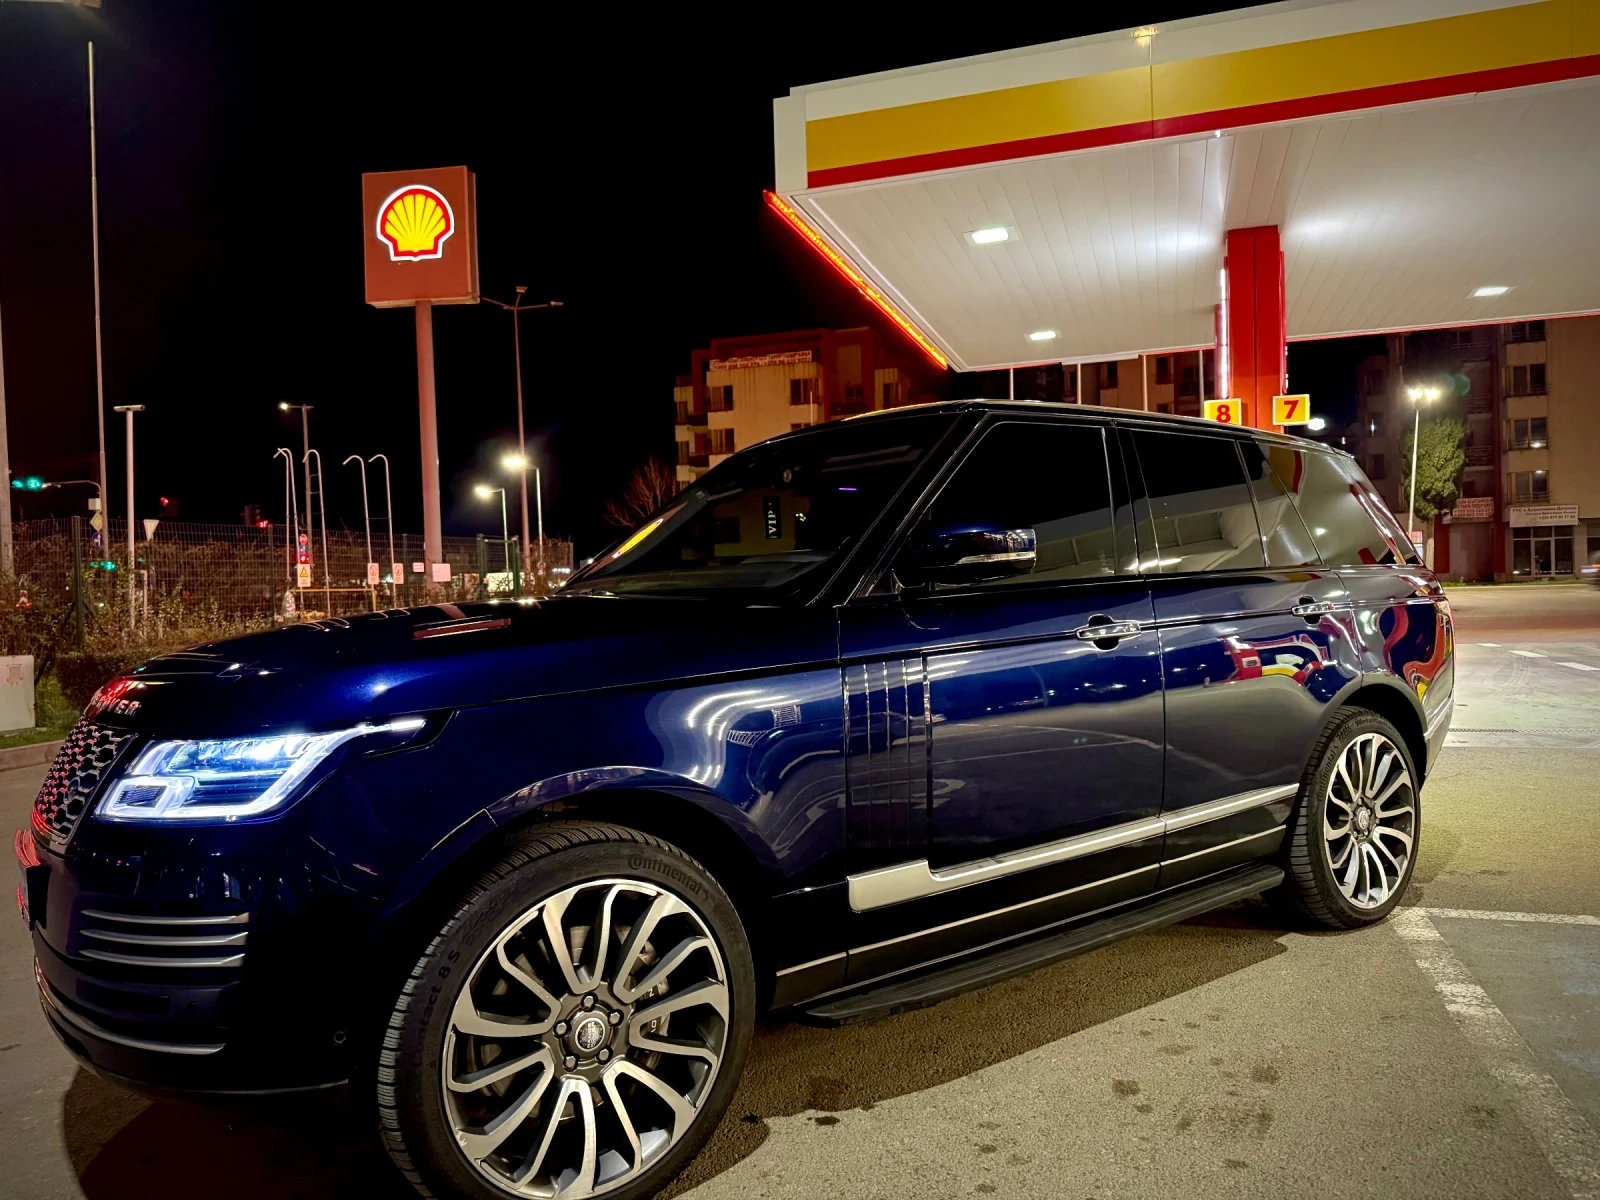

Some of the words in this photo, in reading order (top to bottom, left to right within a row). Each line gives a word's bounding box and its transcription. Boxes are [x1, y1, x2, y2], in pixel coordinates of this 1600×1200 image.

[1216, 404, 1231, 423] 8
[1283, 400, 1300, 419] 7
[627, 853, 701, 896] Continental
[438, 966, 450, 979] 8
